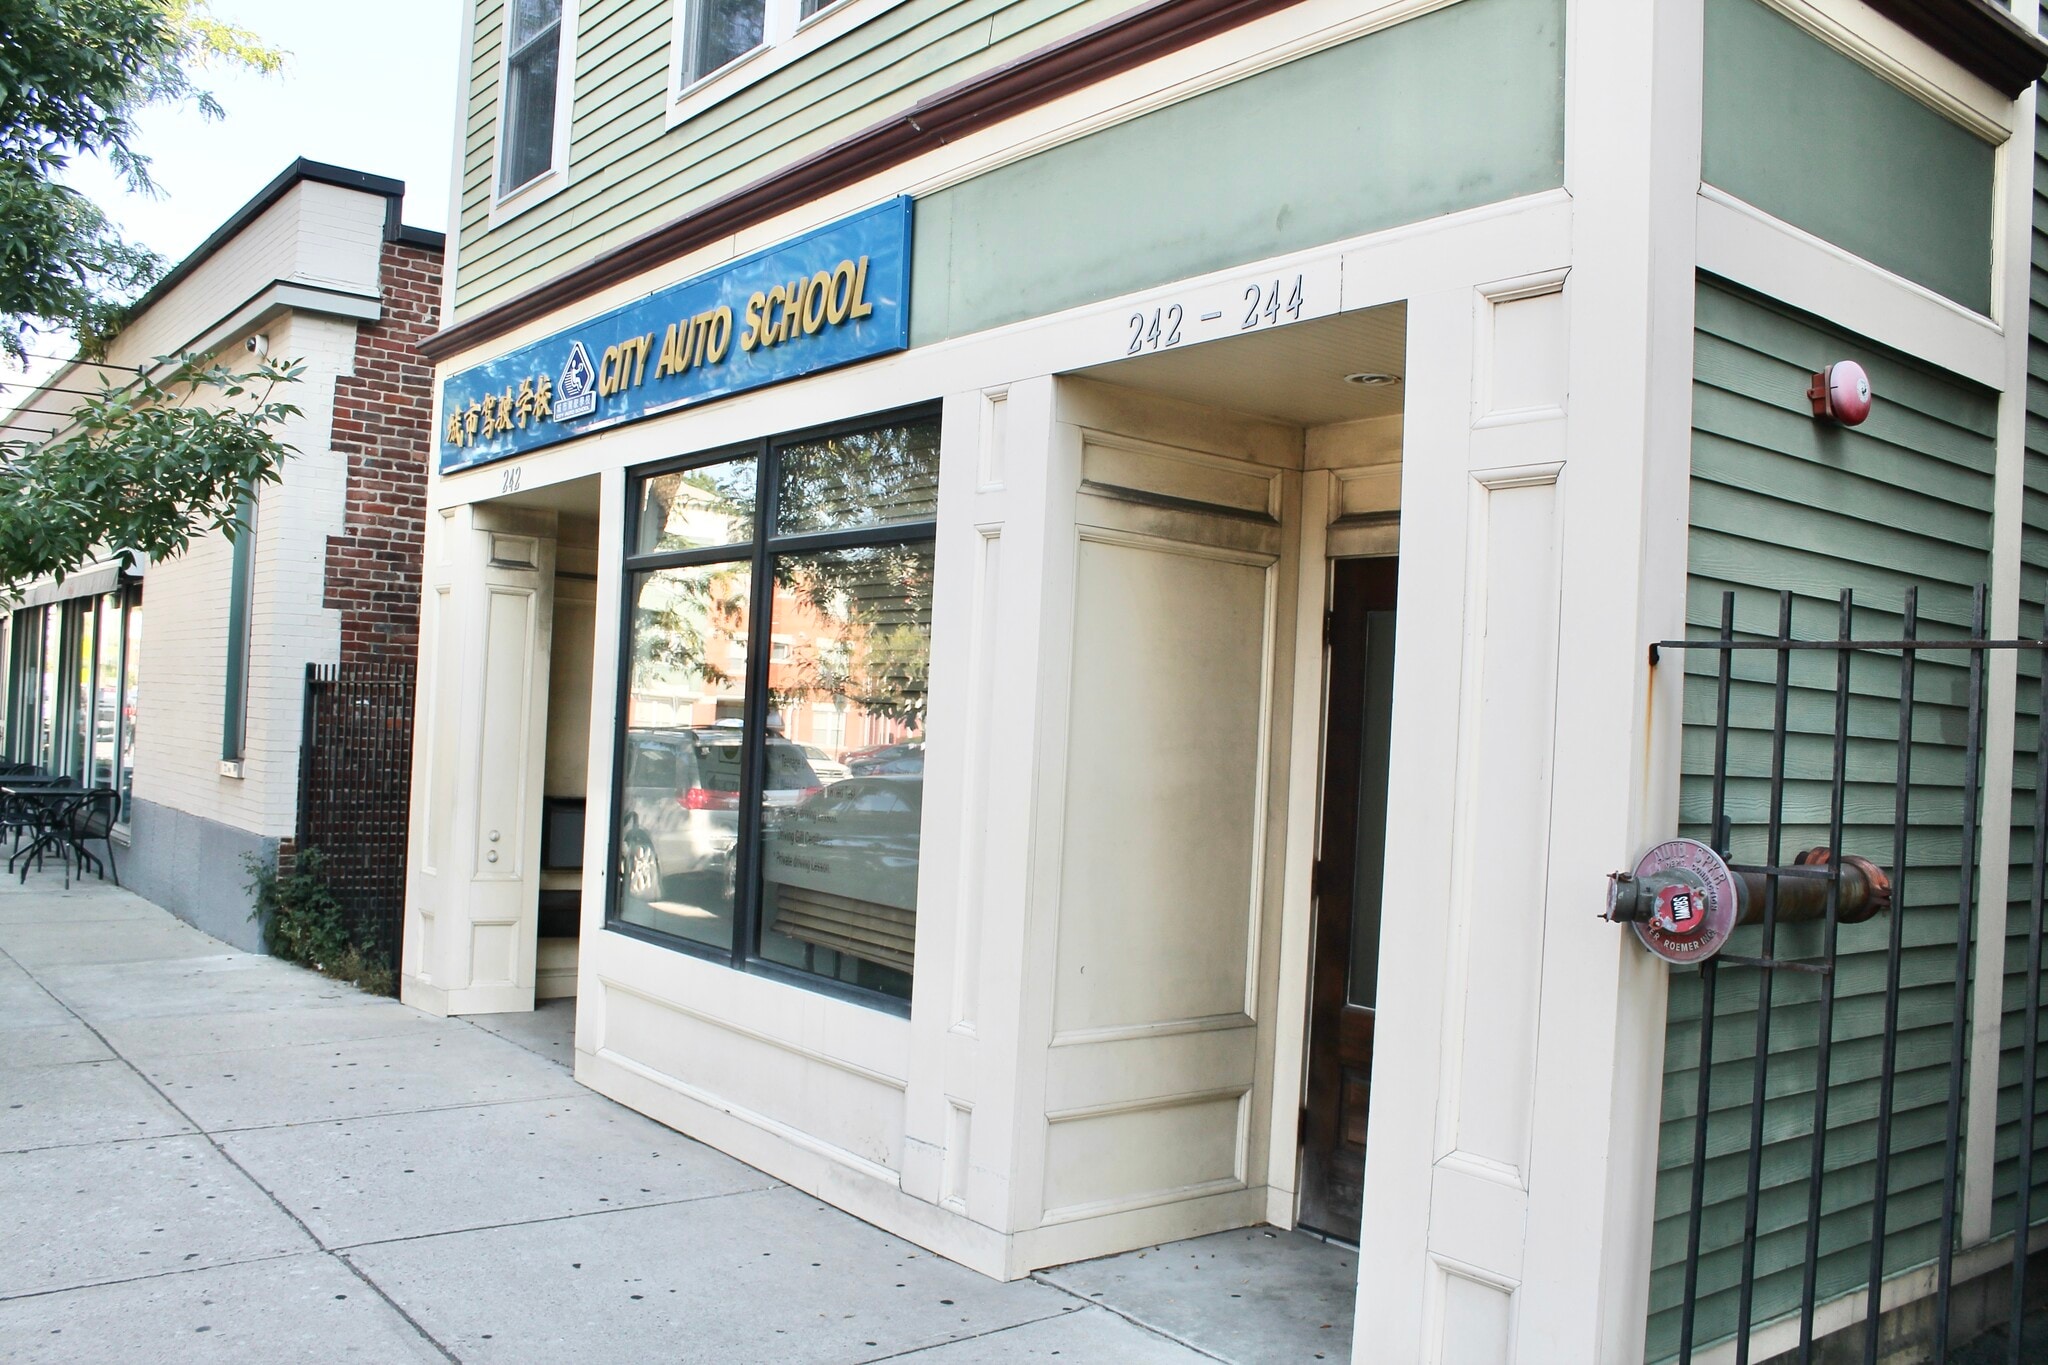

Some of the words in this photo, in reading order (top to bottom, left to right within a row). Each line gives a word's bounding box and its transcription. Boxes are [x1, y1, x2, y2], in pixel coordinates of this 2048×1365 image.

[599, 332, 655, 398] CITY
[655, 305, 733, 380] AUTO
[740, 255, 873, 351] SCHOOL
[1127, 303, 1183, 355] 242
[1241, 274, 1304, 330] 244
[501, 466, 522, 494] 242
[1664, 939, 1699, 952] ROEMER
